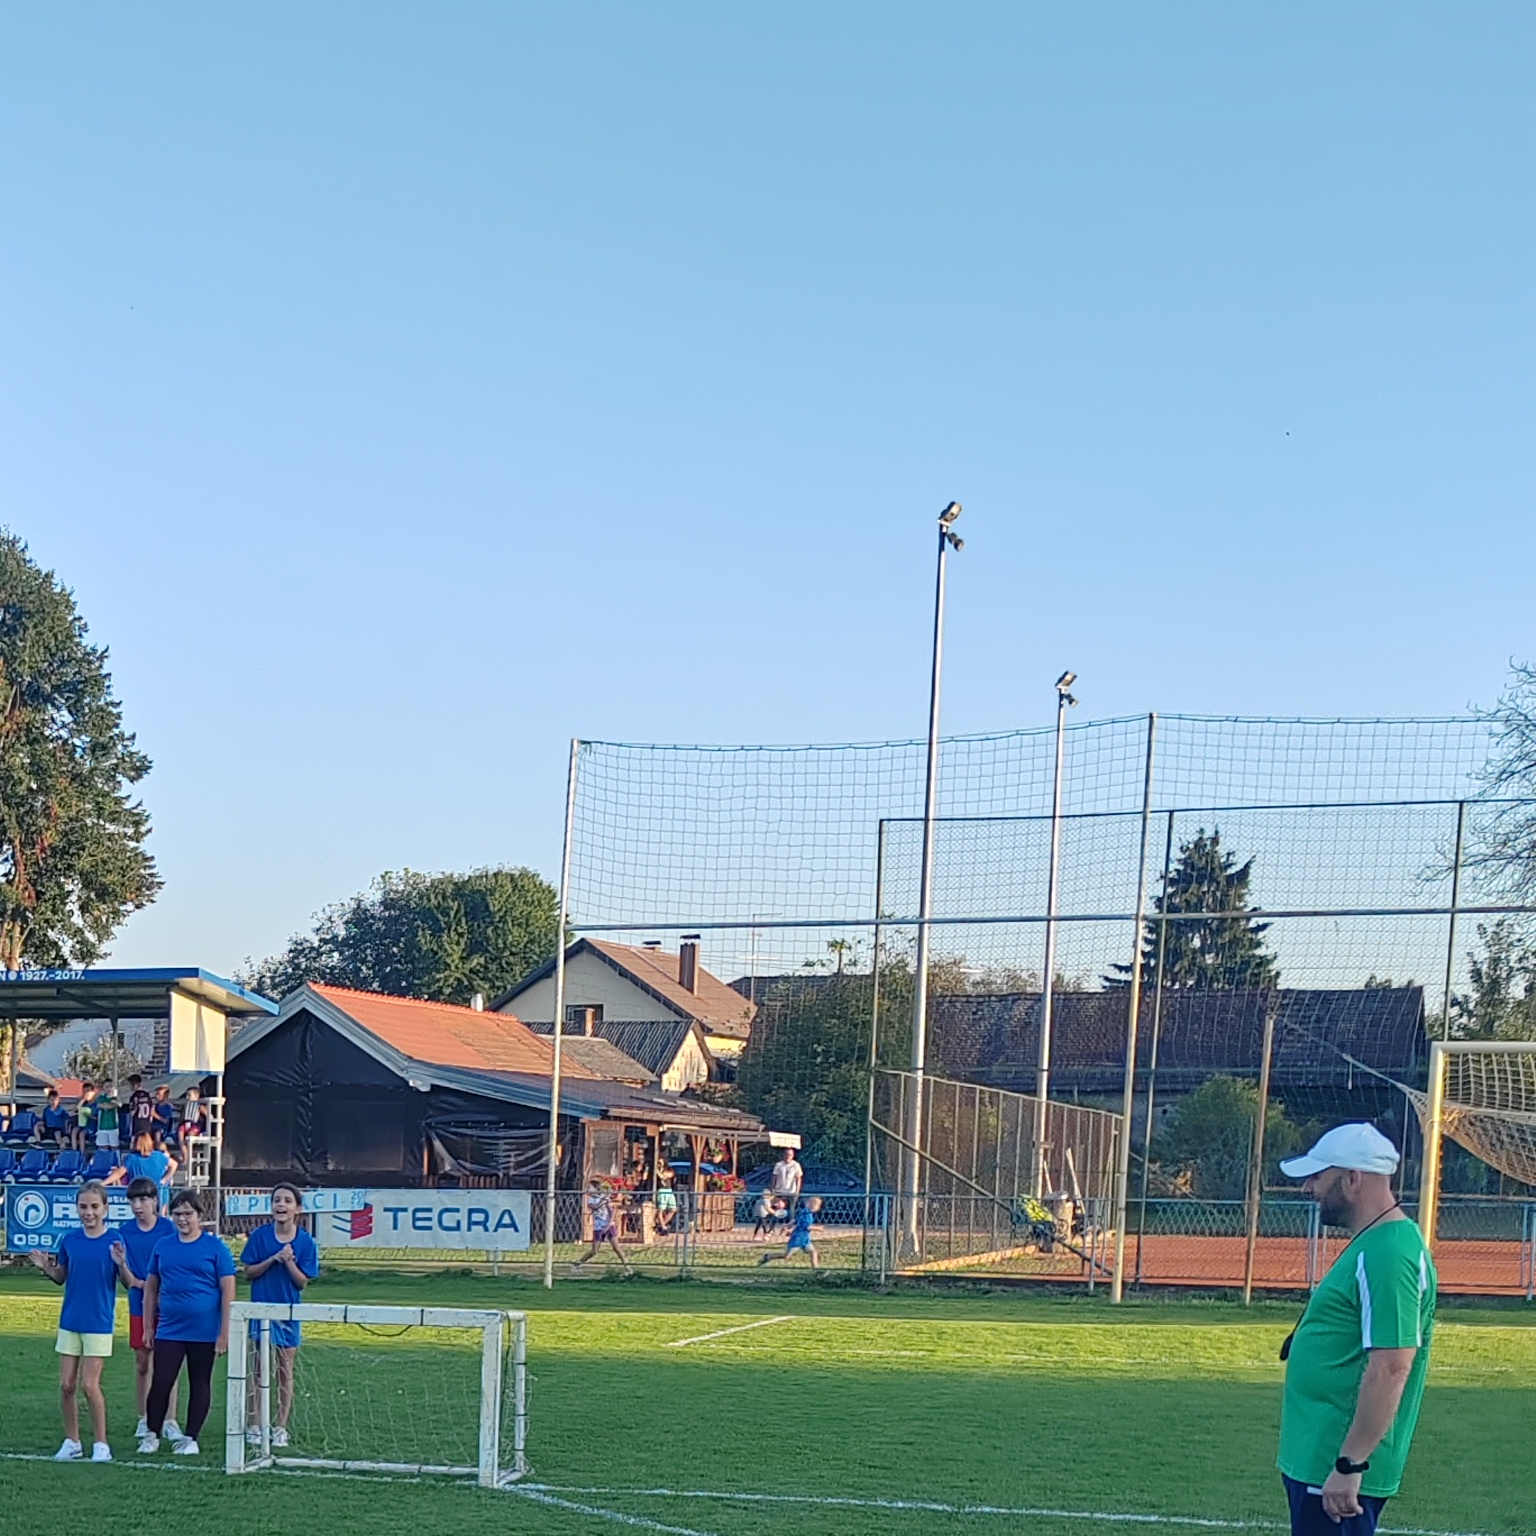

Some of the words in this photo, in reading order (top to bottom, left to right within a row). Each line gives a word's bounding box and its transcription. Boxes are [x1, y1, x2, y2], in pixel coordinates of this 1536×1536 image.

[20, 971, 85, 981] 1927.-2017.
[138, 1103, 150, 1118] 10
[383, 1206, 520, 1233] TEGRA
[13, 1233, 63, 1248] 098/
